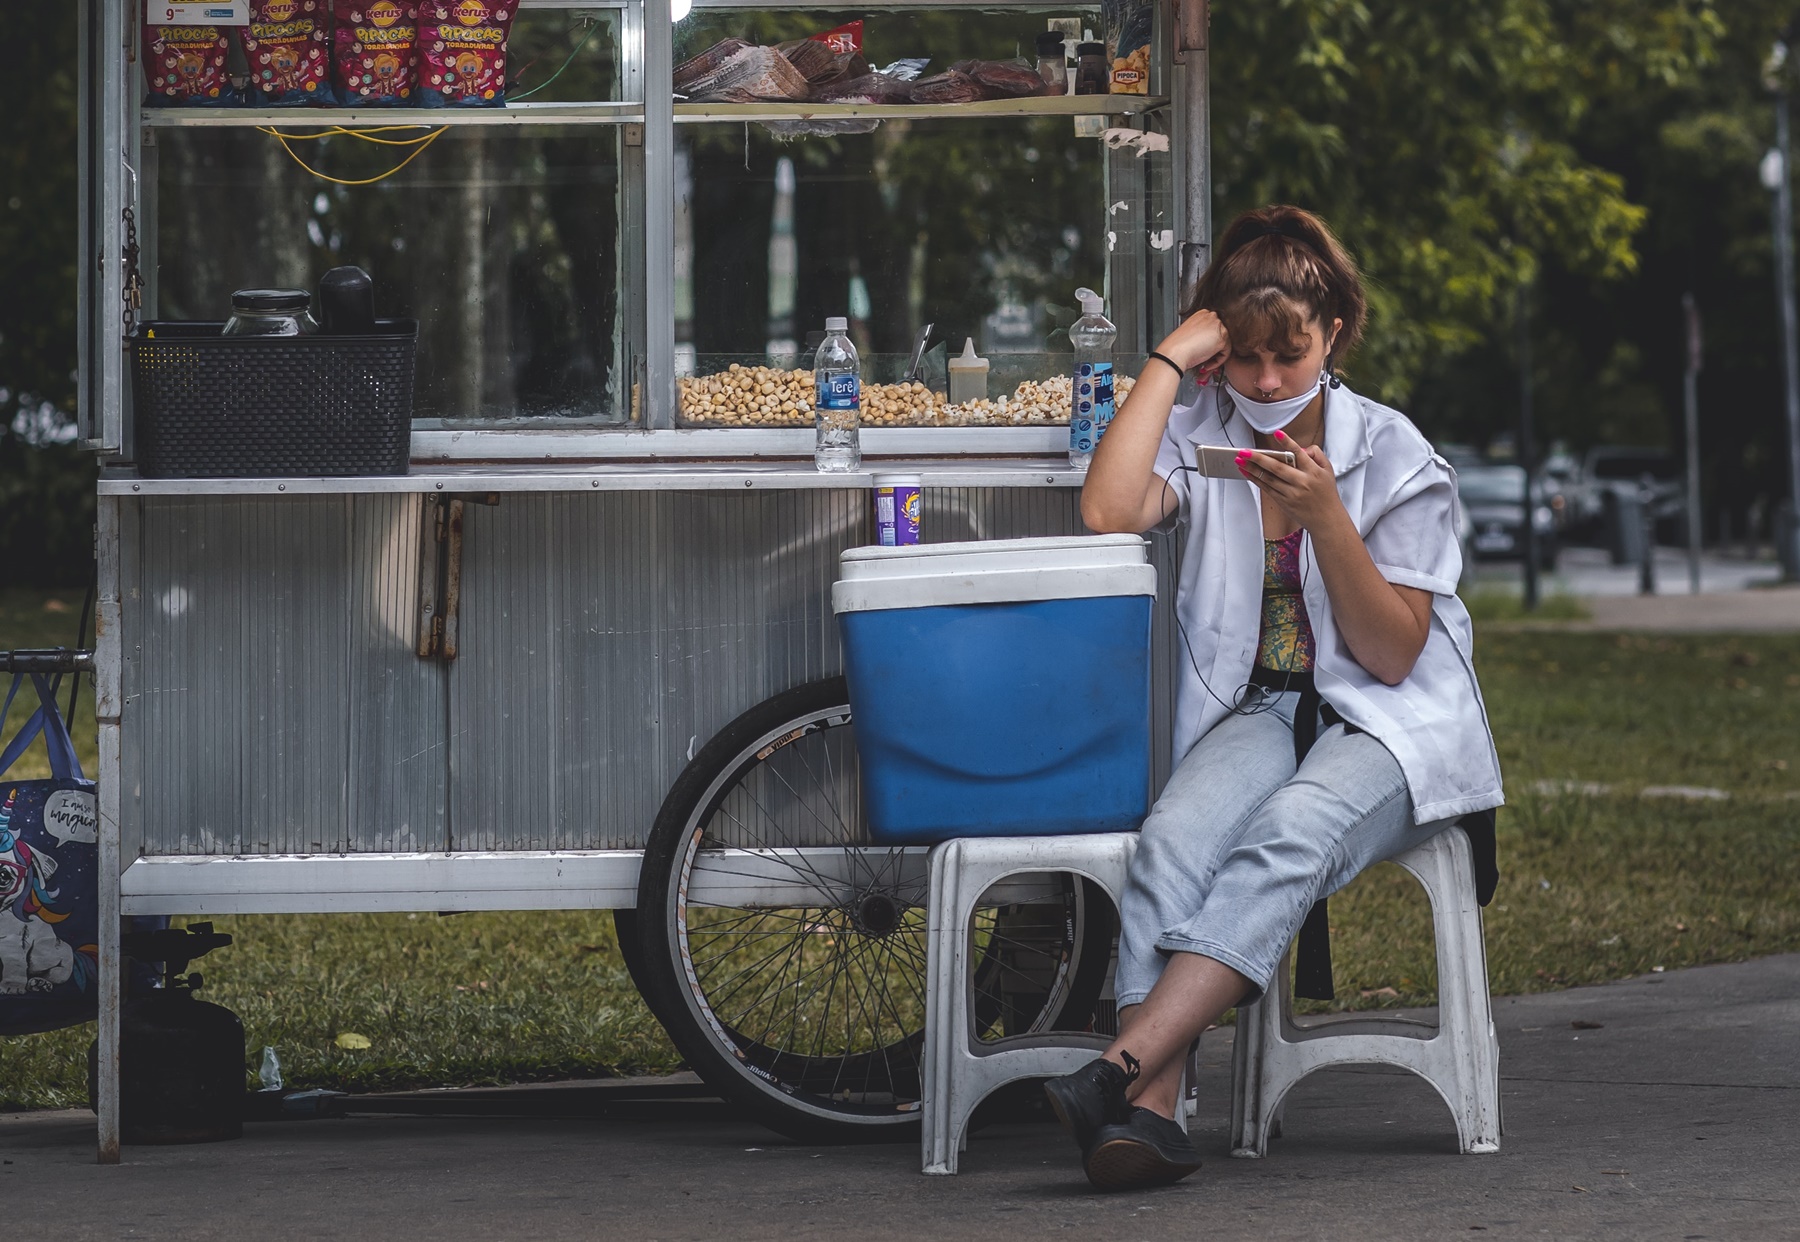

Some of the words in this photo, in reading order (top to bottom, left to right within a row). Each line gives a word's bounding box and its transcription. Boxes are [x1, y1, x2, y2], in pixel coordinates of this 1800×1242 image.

[158, 27, 218, 41] PIPOCAS
[250, 20, 313, 37] PIPOCAS
[354, 27, 416, 43] PIPOCAS
[438, 25, 503, 42] PIPOCAS
[830, 380, 853, 394] Terê
